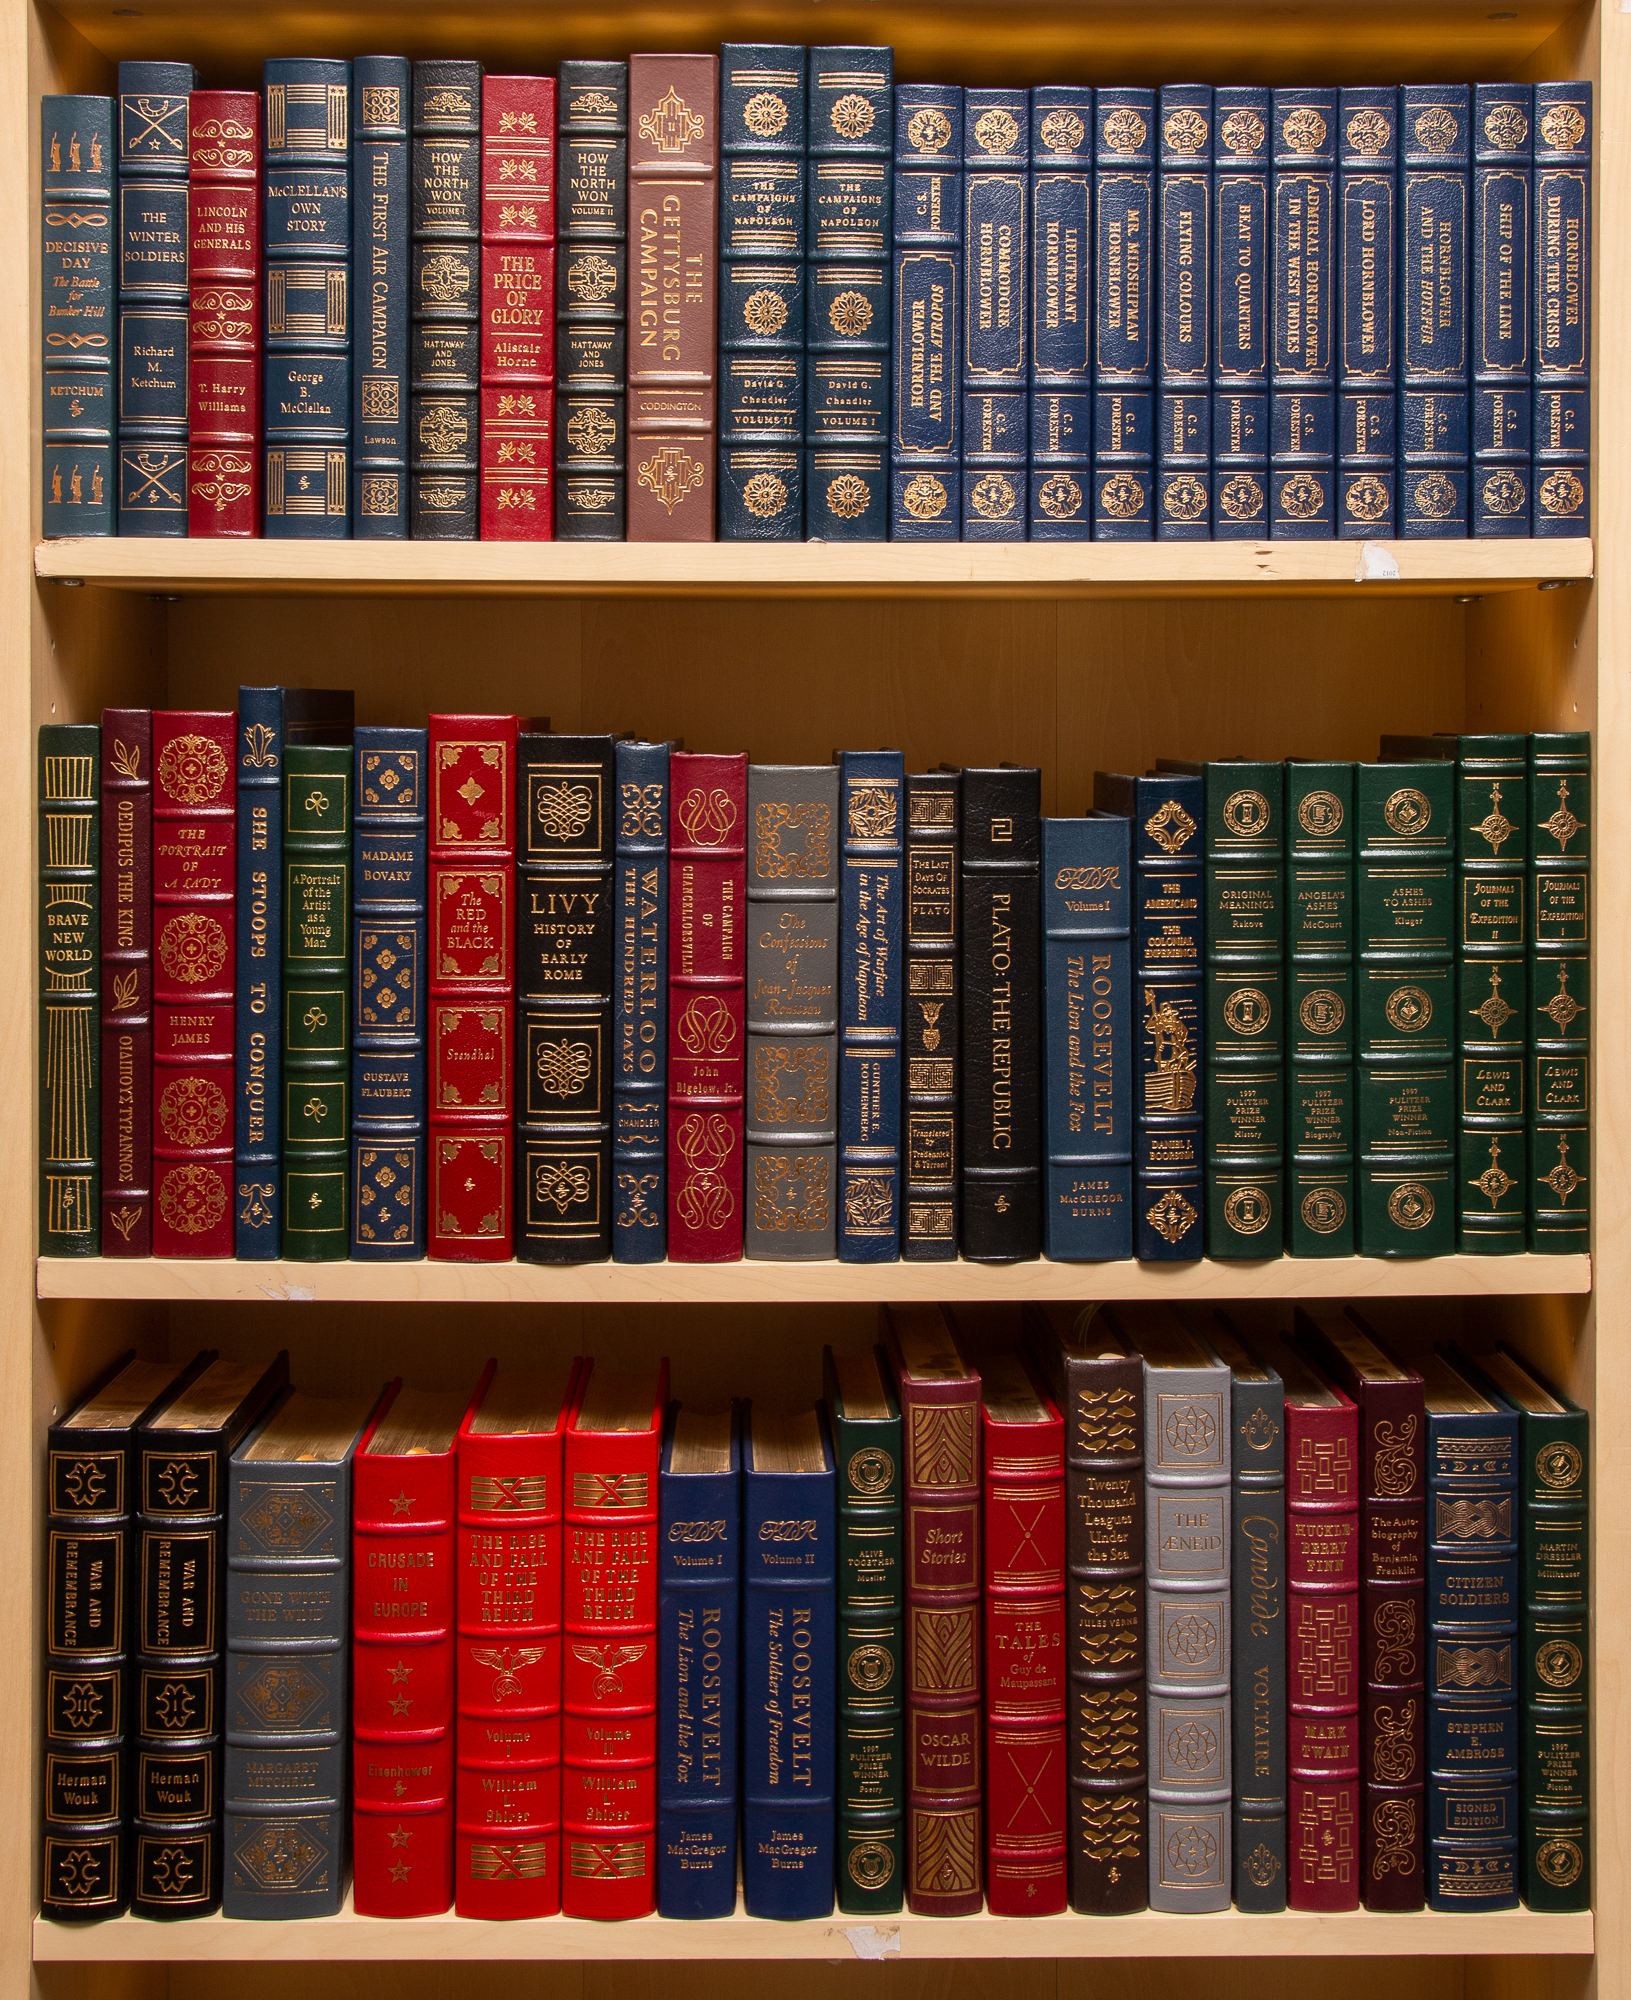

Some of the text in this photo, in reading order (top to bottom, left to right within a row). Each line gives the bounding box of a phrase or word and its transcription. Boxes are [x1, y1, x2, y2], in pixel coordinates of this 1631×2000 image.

[432, 153, 462, 164] HOW
[434, 166, 459, 176] THE
[425, 178, 468, 189] NORTH
[431, 191, 461, 201] WON
[198, 207, 247, 217] LINCOLN
[292, 203, 321, 214] OWN
[142, 213, 166, 223] THE
[200, 223, 244, 233] AND HIS
[287, 220, 326, 231] STORY
[129, 232, 180, 243] WINTER
[46, 242, 108, 253] DECISIVE
[194, 239, 251, 250] GENERALS
[125, 251, 184, 262] SOLDIERS
[372, 152, 389, 368] THE FIRST AIR CAMPAIGN
[63, 258, 90, 269] DAY
[501, 256, 534, 272] THE
[1179, 211, 1192, 342] FLYING COLOURS
[1235, 204, 1251, 349] BEAT TO QUARTERS
[1362, 200, 1375, 355] LORD HORNBLOWER
[1499, 204, 1512, 339] SHIP OF THE LINE
[494, 274, 541, 290] PRICE
[640, 209, 657, 347] CAMPAIGN
[663, 195, 680, 361] GETTYSBURG
[686, 253, 702, 303] THE
[507, 291, 527, 306] OF
[491, 309, 543, 325] GLORY
[424, 341, 464, 349] HATTAWAY
[494, 343, 540, 353] Alistair
[432, 359, 456, 367] JONES
[497, 356, 536, 366] Horne
[289, 371, 323, 385] George
[51, 386, 103, 396] KETCHUM
[199, 384, 245, 395] T. Harry
[300, 387, 311, 397] B.
[199, 402, 246, 412] Williams
[281, 402, 331, 413] McClellan
[640, 402, 701, 411] CODDINGTON
[1174, 400, 1184, 452] FORESTER
[1187, 415, 1197, 437] C. S.
[365, 436, 396, 444] Lawson
[179, 830, 205, 839] THE
[159, 845, 226, 857] PORTRAIT
[363, 851, 413, 861] MADAME
[183, 862, 198, 872] OF
[117, 801, 133, 946] OEDIPUS THE KING
[365, 870, 412, 881] BOVARY
[165, 878, 221, 889] A LADY
[1222, 891, 1272, 899] ORIGINAL
[1392, 888, 1423, 896] ASHES
[461, 892, 481, 906] The
[531, 894, 599, 914] LIVY
[1220, 901, 1274, 909] MEANINGS
[1384, 898, 1432, 906] TO ASHES
[1065, 901, 1103, 911] Volume
[48, 914, 88, 925] BRAVE
[457, 908, 486, 920] RED
[451, 922, 488, 933] and the
[534, 924, 595, 934] HISTORY
[54, 933, 84, 943] NEW
[447, 936, 493, 949] BLACK
[557, 940, 571, 948] OF
[46, 950, 92, 961] WORLD
[542, 954, 587, 964] EARLY
[246, 808, 267, 1143] SHE STOOPS TO CONQUER
[545, 970, 582, 980] ROME
[639, 867, 658, 1072] WATERLOO
[170, 1016, 215, 1027] HENRY
[991, 893, 1012, 1149] PLATO: THE REPUBLIC
[172, 1033, 210, 1046] JAMES
[1093, 955, 1112, 1135] ROOSEVELT
[447, 1048, 494, 1061] Stendhal
[1545, 1067, 1578, 1077] LEWIS
[1551, 1080, 1573, 1088] AND
[1545, 1092, 1579, 1103] CLARK
[1074, 1181, 1109, 1189] JAMES
[1073, 1208, 1110, 1216] BURNS
[1087, 1478, 1130, 1493] Twenty
[1078, 1495, 1135, 1508] Thousand
[1085, 1513, 1131, 1530] Leagues
[1173, 1514, 1209, 1528] THE
[926, 1528, 963, 1544] Short
[1295, 1524, 1354, 1537] HUCKLE-
[1090, 1532, 1128, 1544] Under
[1301, 1542, 1346, 1554] BERRY
[370, 1552, 434, 1568] CRUSADE
[762, 1554, 814, 1564] Volume II
[921, 1549, 966, 1564] Stories
[1088, 1548, 1129, 1561] the Sea
[1307, 1560, 1344, 1572] FINN
[1241, 1515, 1279, 1636] Candide
[394, 1577, 408, 1592] IN
[1447, 1577, 1503, 1588] CITIZEN
[158, 1541, 171, 1645] REMEMBRANCE
[183, 1560, 195, 1627] WAR AND
[241, 1591, 330, 1604] GONE WITH
[1440, 1593, 1509, 1605] SOLDIERS
[247, 1608, 323, 1621] THE WIND
[374, 1602, 427, 1617] EUROPE
[792, 1608, 811, 1786] ROOSEVELT
[1254, 1665, 1269, 1777] VOLTAIRE
[1305, 1726, 1346, 1739] MARK
[1448, 1723, 1503, 1733] STEPHEN
[921, 1733, 970, 1747] OSCAR
[1471, 1737, 1481, 1746] E.
[1302, 1745, 1349, 1758] TWAIN
[1446, 1748, 1504, 1759] AMBROSE
[921, 1753, 970, 1766] WILDE
[368, 1765, 432, 1777] Eisenhower
[58, 1774, 106, 1786] Herman
[64, 1792, 98, 1805] Wouk
